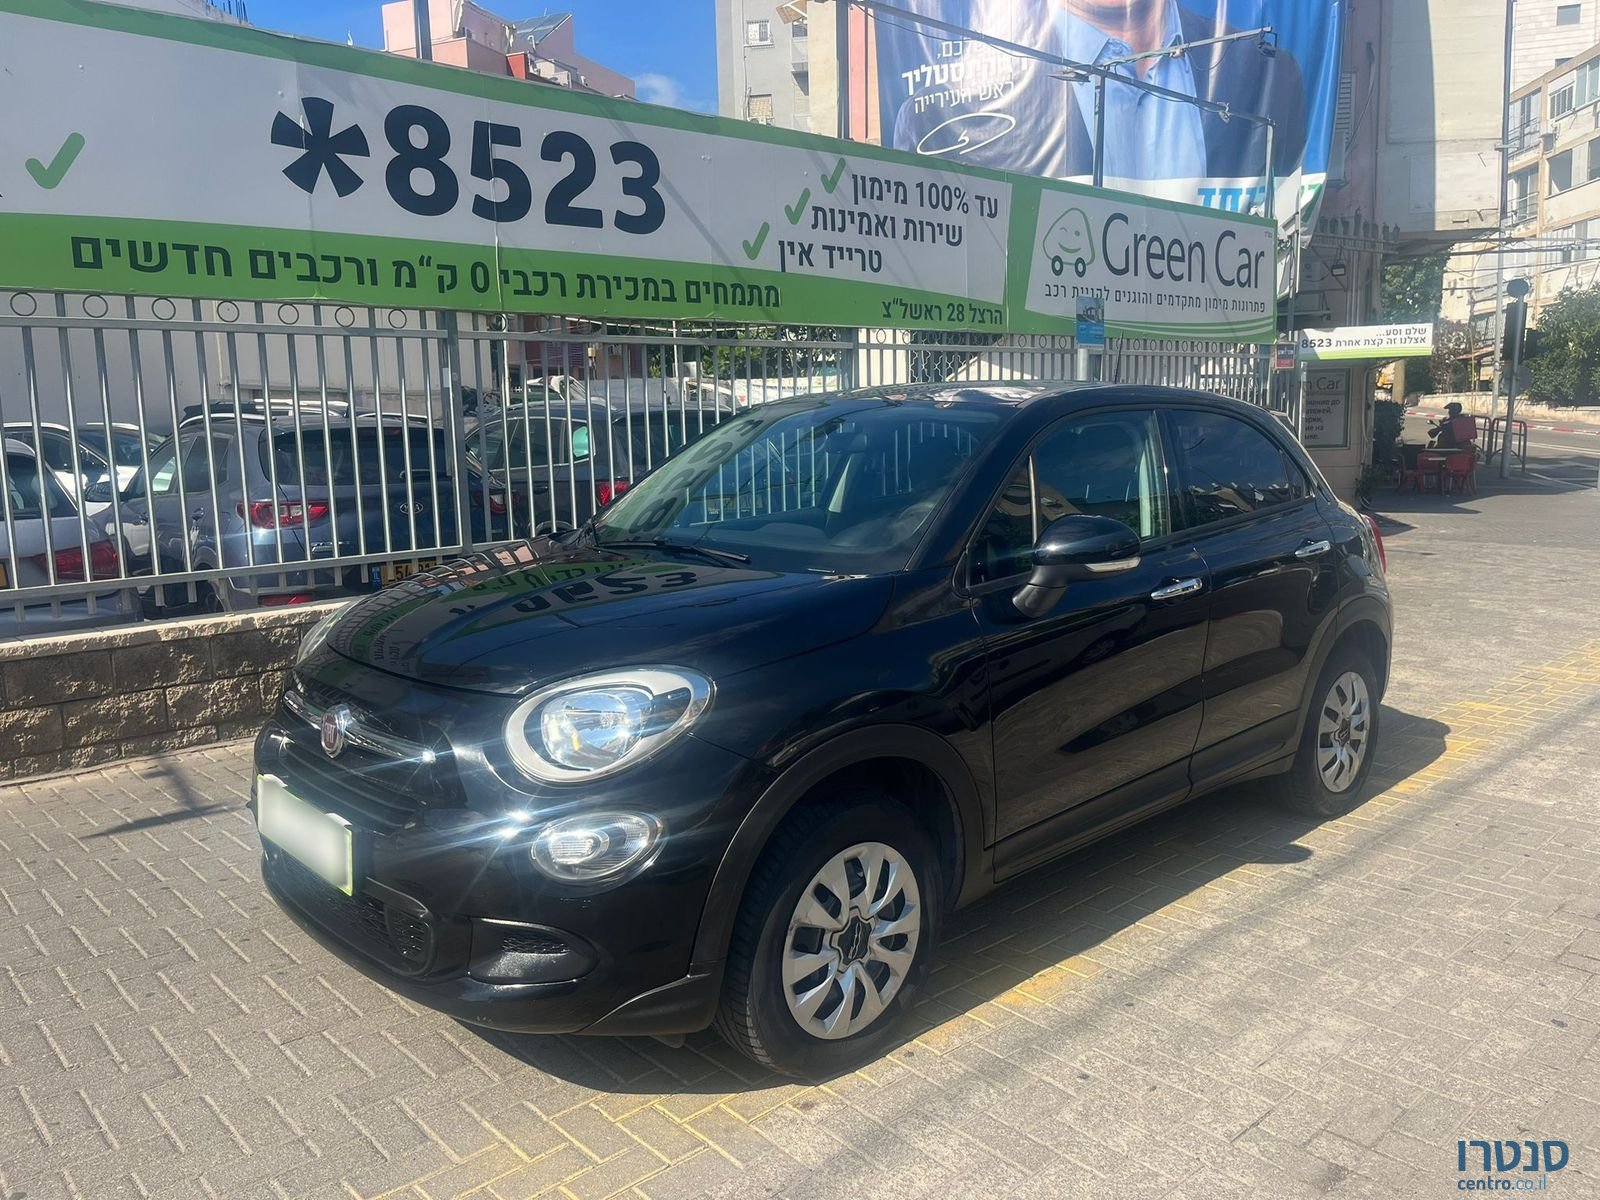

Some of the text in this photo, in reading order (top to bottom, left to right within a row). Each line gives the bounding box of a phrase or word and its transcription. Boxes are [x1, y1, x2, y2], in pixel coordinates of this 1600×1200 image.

[979, 80, 1013, 100] ראש
[851, 173, 998, 219] עד 100% מימון
[811, 206, 963, 247] שירות ואמינות
[777, 239, 882, 273] טרייד אין
[1102, 212, 1266, 289] Green Car
[71, 236, 780, 308] מתמחים במכירת רכבי 0 ק"מ ורכבים חדשים
[1045, 283, 1067, 298] רכב
[1114, 289, 1152, 305] והוגנים
[880, 296, 1004, 325] הרצל 28 ראשל"צ
[1156, 293, 1201, 311] מתקדמים
[1205, 298, 1229, 313] מימון
[1232, 299, 1265, 313] פתרונות
[1405, 327, 1427, 335] שלם
[1301, 336, 1426, 349] אצלנו זה קצת אחרת 8523
[1316, 377, 1341, 390] Car
